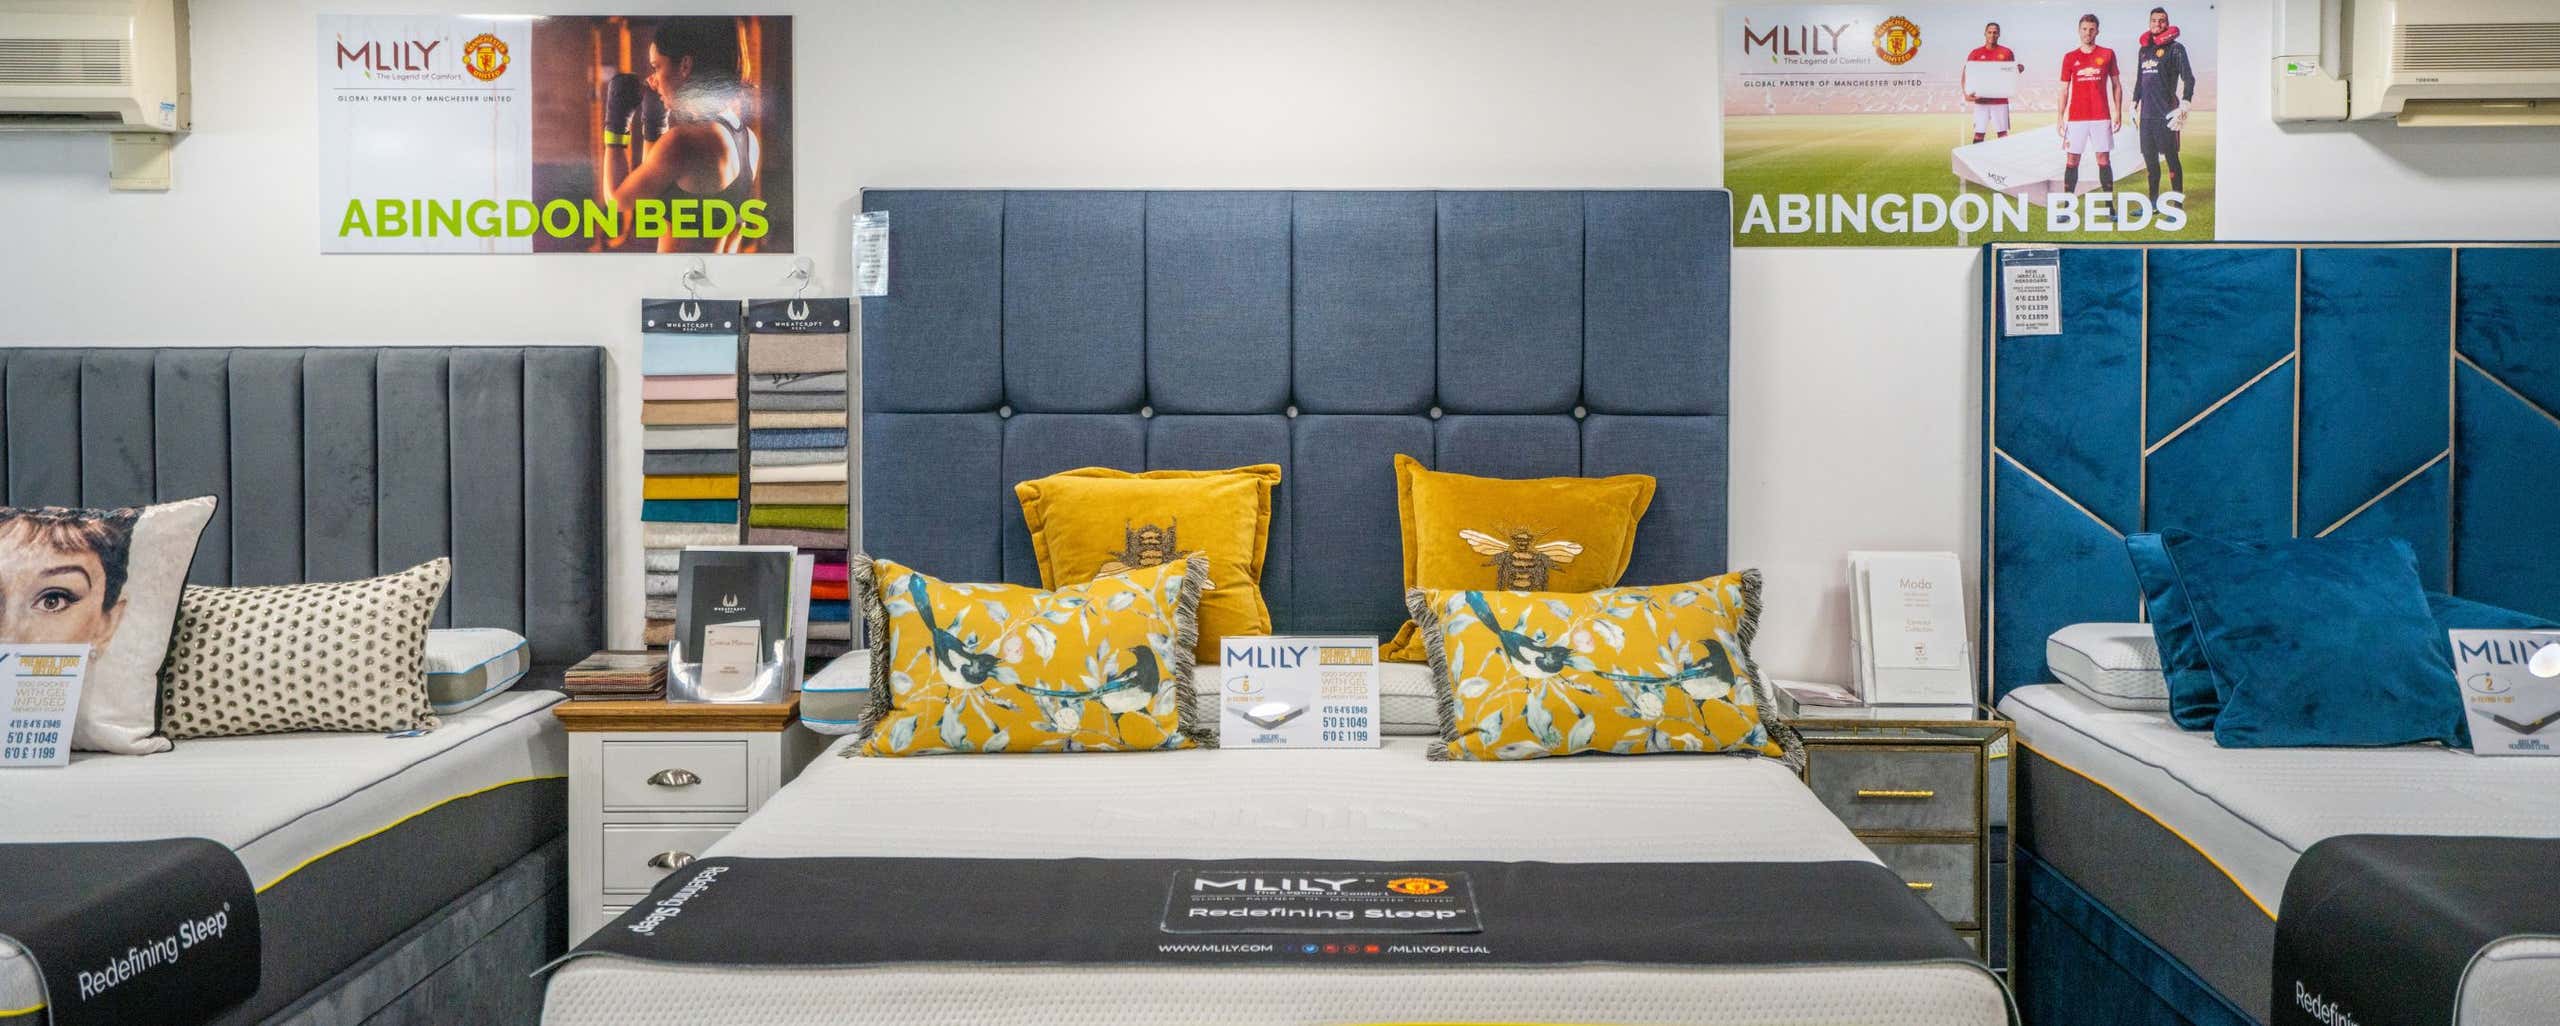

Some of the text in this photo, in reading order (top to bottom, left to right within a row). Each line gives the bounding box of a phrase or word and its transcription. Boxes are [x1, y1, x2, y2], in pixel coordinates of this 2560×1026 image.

[1744, 24, 1850, 55] MLILY
[337, 40, 440, 71] MLILY
[1784, 57, 1798, 65] The
[1800, 57, 1827, 66] Legend
[376, 72, 391, 80] The
[392, 72, 420, 81] Legend
[431, 73, 462, 81] Comfort
[1744, 80, 1776, 88] GLOBAL
[1834, 79, 1889, 87] MANCHESTER
[1893, 79, 1922, 87] UNITED
[338, 198, 769, 240] ABINGDON BEDS
[1739, 191, 2187, 235] ABINGDON BEDS
[1900, 578, 1932, 589] Moda
[1227, 646, 1308, 668] MLILY
[1323, 717, 1368, 728] 5'0 £1049
[7, 732, 58, 744] 5'0 £1049
[1323, 730, 1337, 742] 6'0
[4, 747, 20, 759] 6'0
[657, 866, 729, 907] Redefining
[1194, 878, 1358, 891] MLILY
[1189, 907, 1456, 920] Redefining Sleep
[1158, 944, 1490, 954] WWW.MLILY.COM /MLILYOFFICIAL
[78, 910, 228, 1002] Redefining Sleep
[2295, 980, 2360, 1026] Redefini
